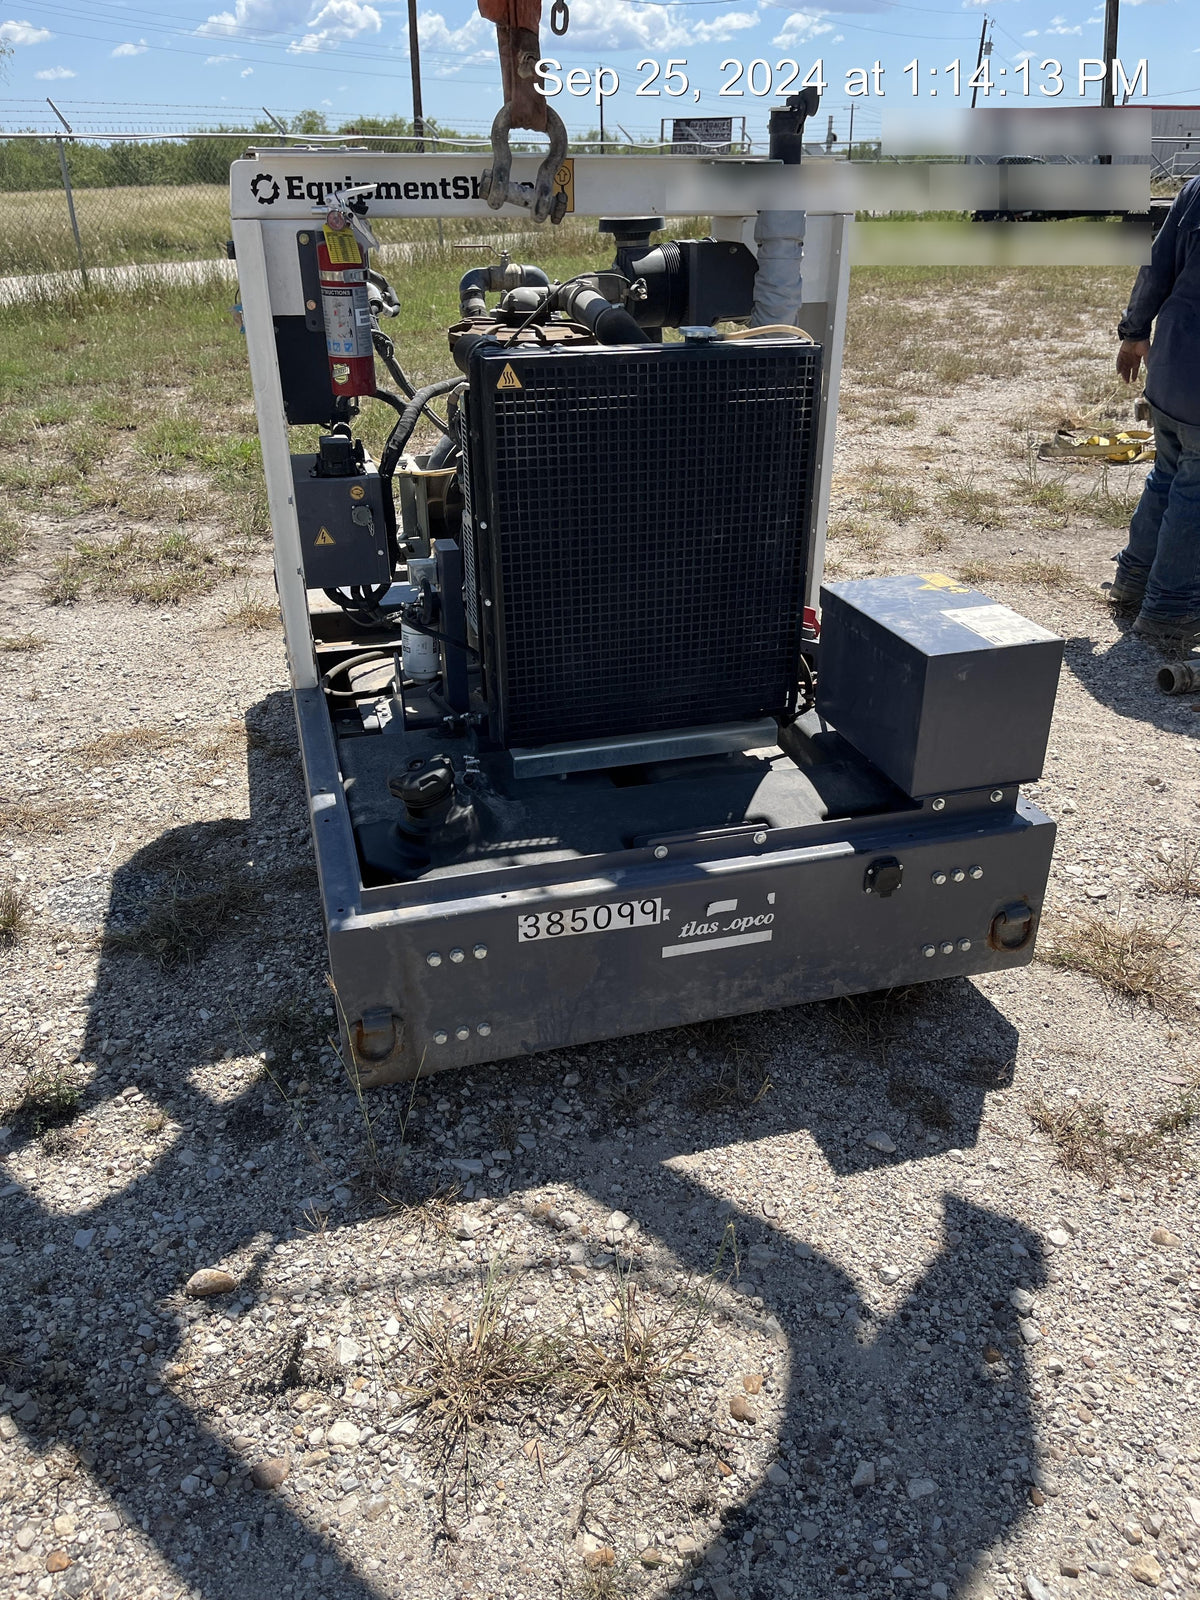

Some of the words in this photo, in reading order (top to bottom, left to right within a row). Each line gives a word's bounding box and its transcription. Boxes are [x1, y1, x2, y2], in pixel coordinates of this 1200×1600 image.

[521, 898, 658, 939] 385099
[678, 921, 719, 938] tlas
[722, 913, 775, 932] opco
